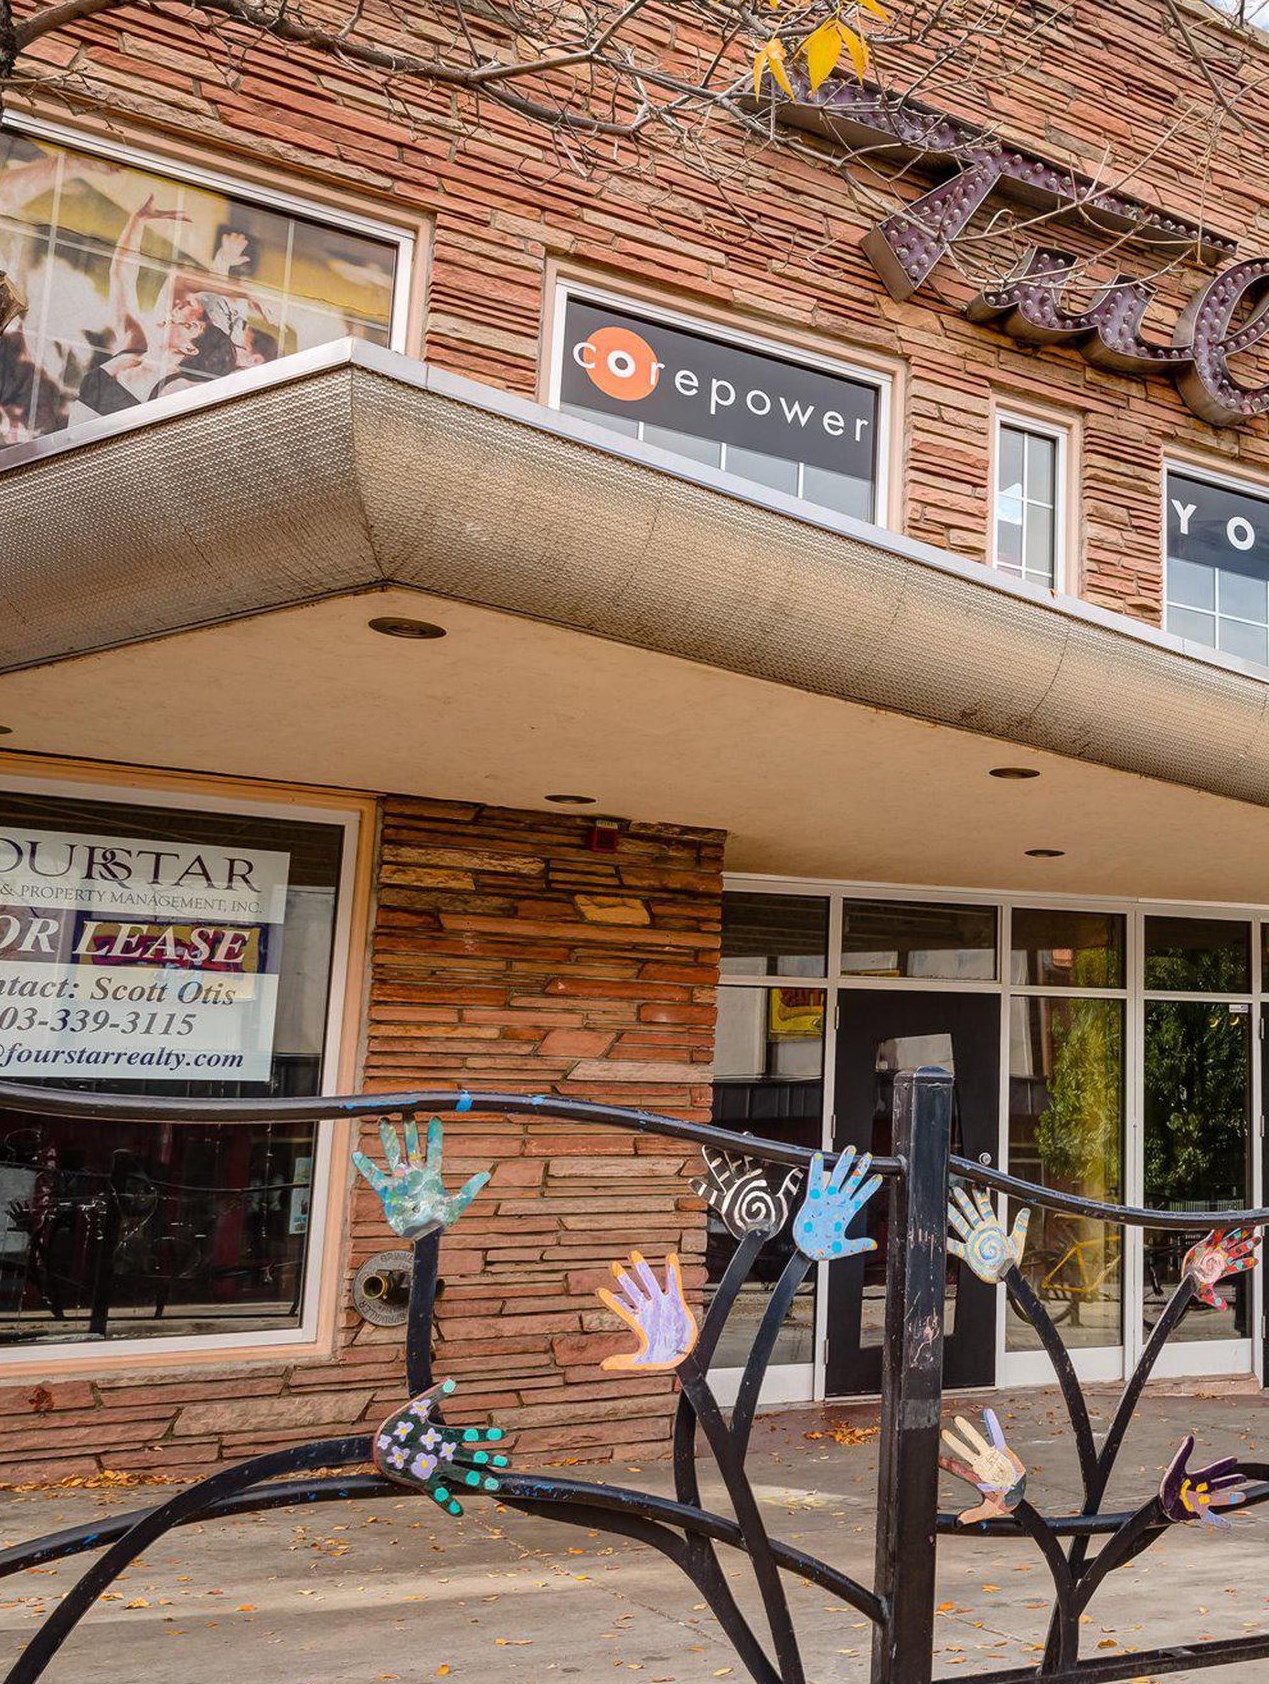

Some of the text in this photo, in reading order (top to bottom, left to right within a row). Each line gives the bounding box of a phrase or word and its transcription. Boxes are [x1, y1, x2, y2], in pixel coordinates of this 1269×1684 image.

[572, 341, 869, 442] corepower
[0, 884, 263, 914] & PROPERTY MANAGEMENT, INC.
[72, 920, 252, 963] LEASE
[90, 976, 169, 1003] Scott
[178, 981, 236, 1006] Otis
[0, 1005, 197, 1036] 03-339-3115
